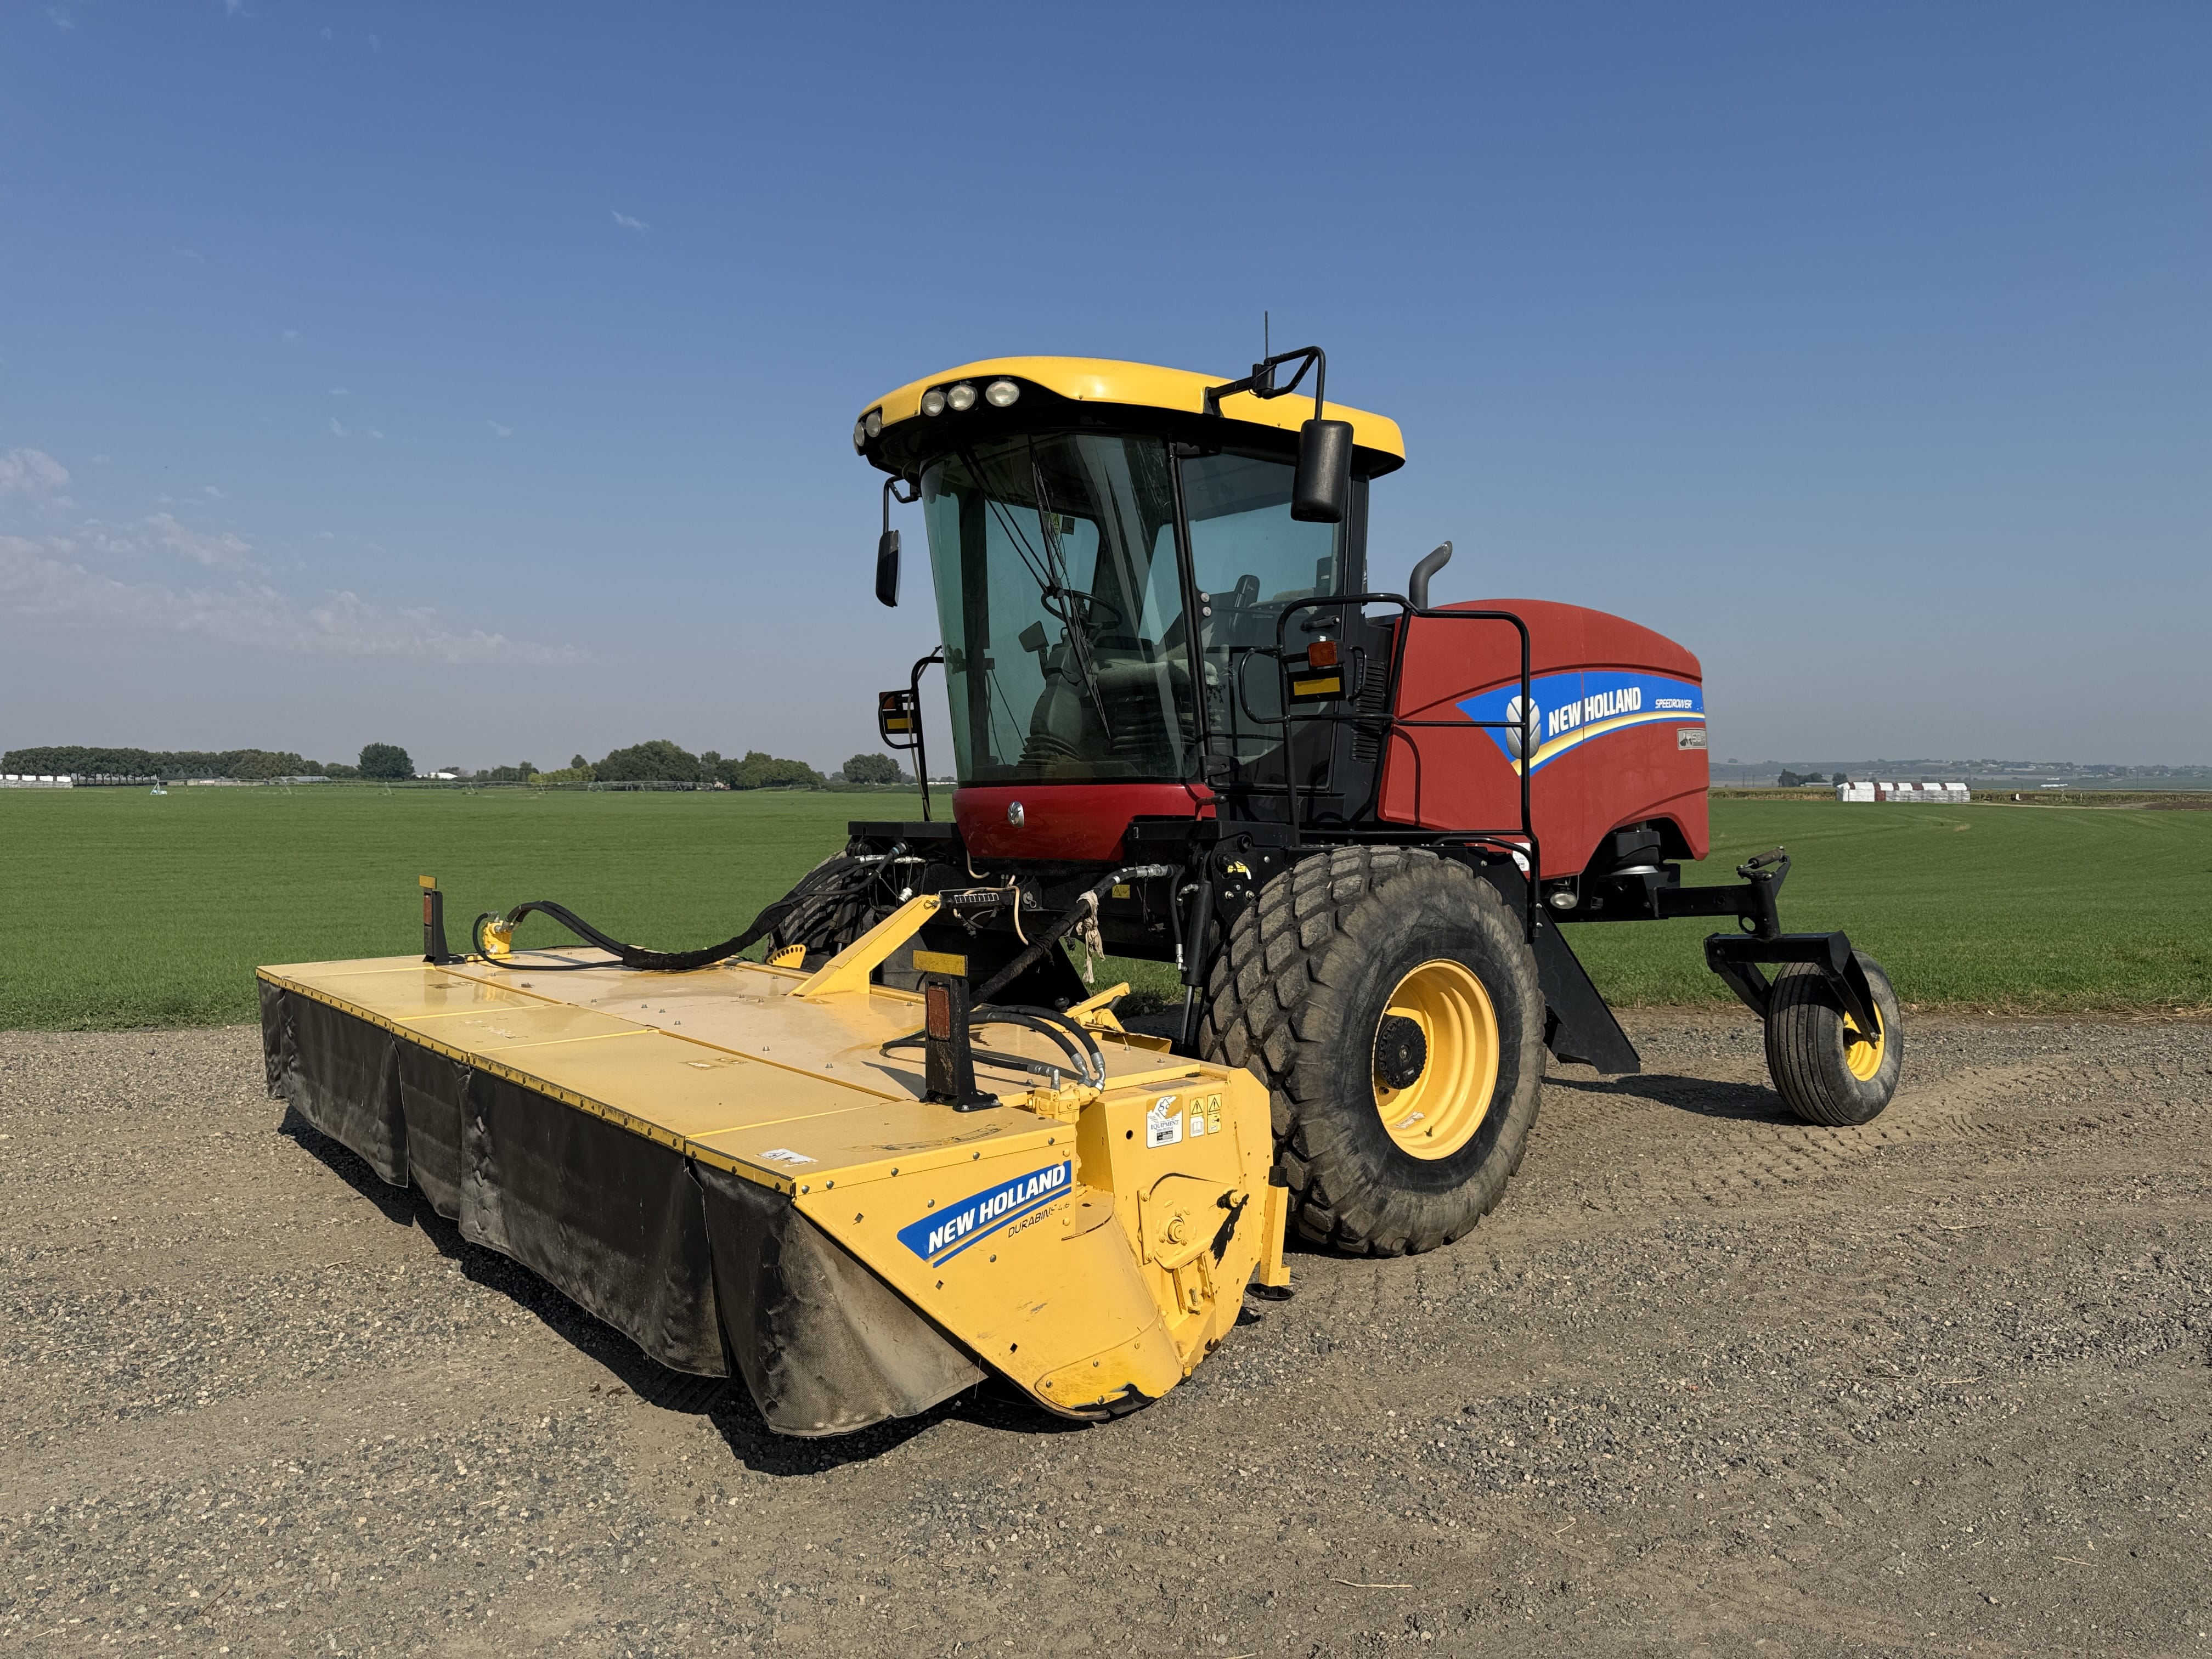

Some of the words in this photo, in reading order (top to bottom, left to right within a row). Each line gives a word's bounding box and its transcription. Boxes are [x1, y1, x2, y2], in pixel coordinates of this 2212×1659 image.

[1549, 700, 1582, 737] NEW
[1584, 687, 1641, 723] HOLLAND
[1655, 698, 1692, 709] SPEEDROWER
[928, 1207, 975, 1254] NEW
[979, 1164, 1065, 1224] HOLLAND
